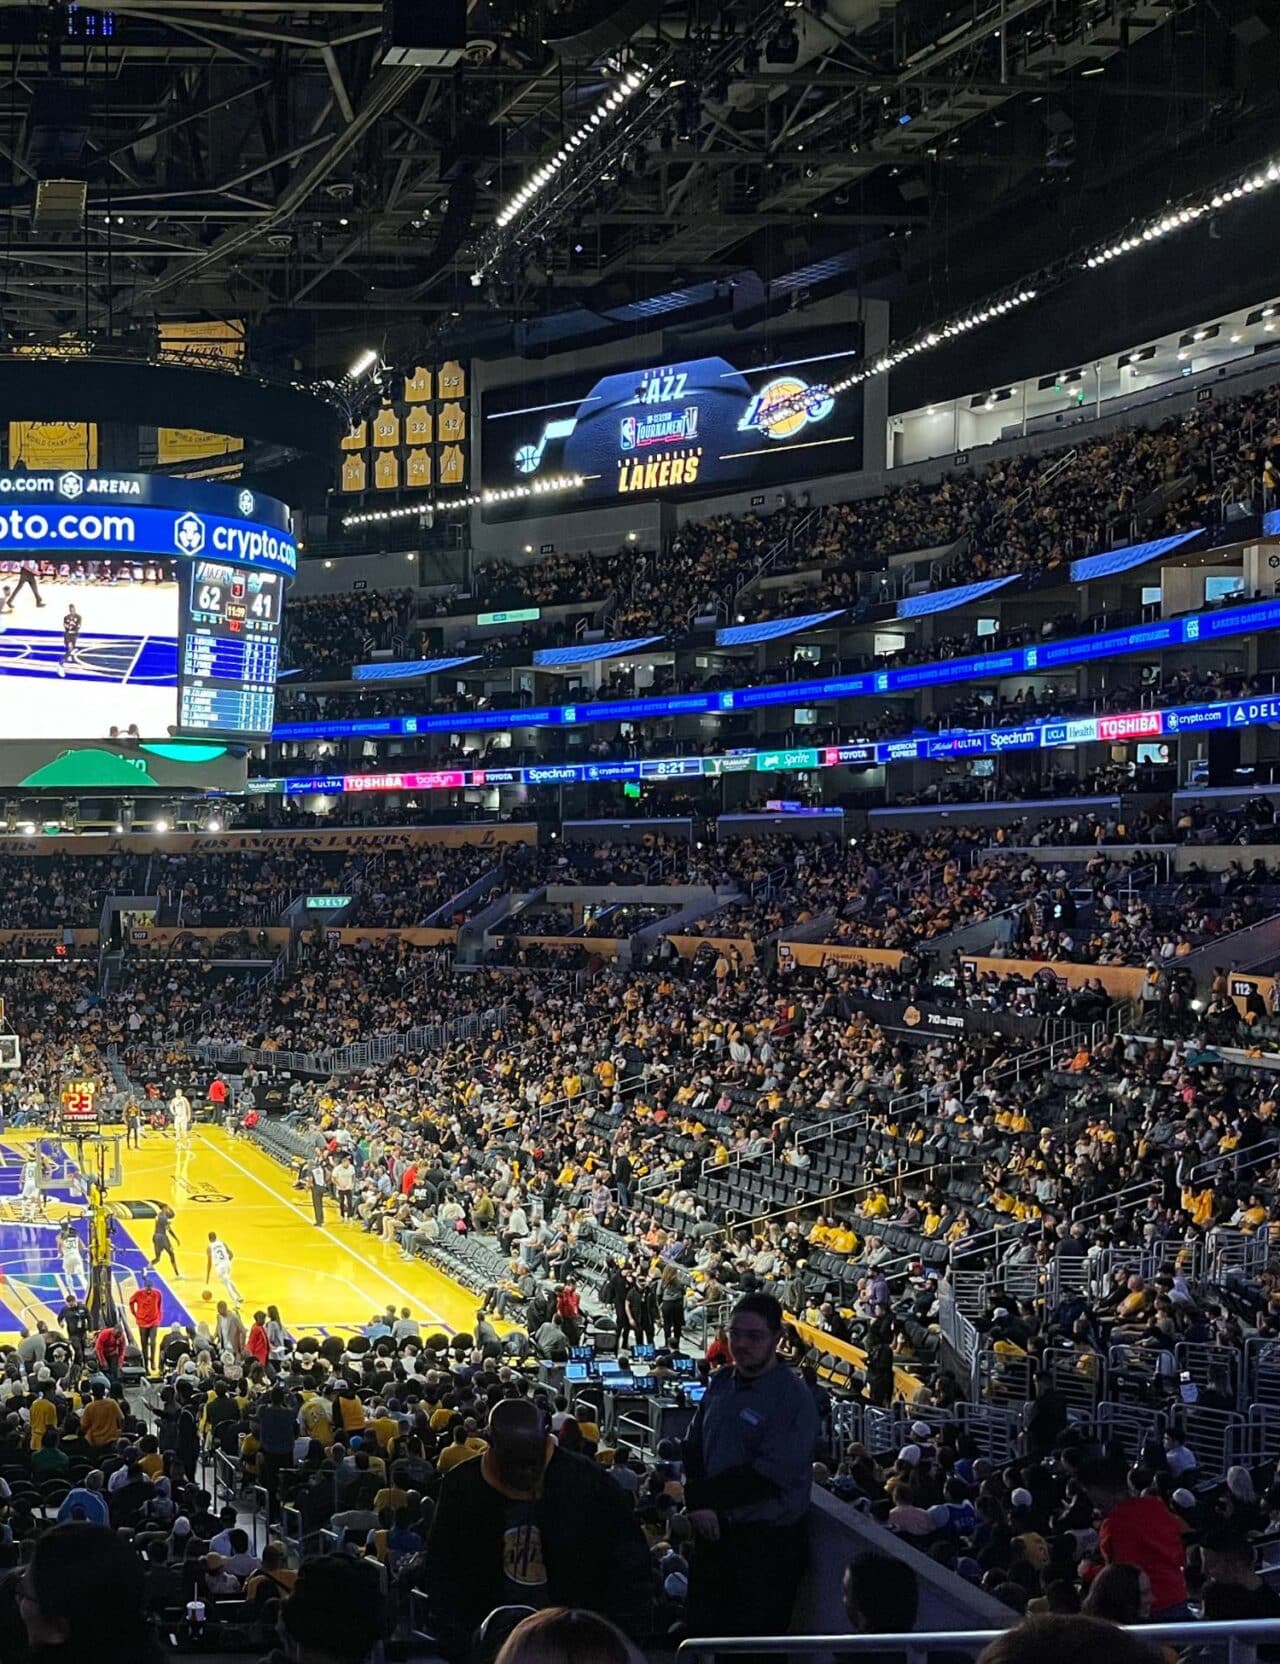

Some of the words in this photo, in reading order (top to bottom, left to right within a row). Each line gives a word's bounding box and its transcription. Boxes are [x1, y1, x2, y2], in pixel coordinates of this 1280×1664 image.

[444, 376, 460, 387] 25
[445, 418, 459, 430] 42
[635, 413, 689, 446] TOURNAMENT
[412, 463, 425, 474] 24
[618, 456, 700, 493] LAKERS
[87, 479, 141, 495] ARENA
[234, 585, 241, 596] 3
[199, 585, 221, 610] 62
[252, 593, 272, 618] 41
[1249, 702, 1280, 719] DEL
[1179, 711, 1221, 726] crypto.com
[1047, 729, 1064, 739] UCLA
[1069, 725, 1095, 738] Health
[1101, 716, 1158, 736] TOSHIBA
[958, 738, 982, 749] ULTRA
[991, 731, 1034, 748] Spectrum
[887, 742, 917, 752] AMERICAN
[784, 752, 810, 765] Sprite
[838, 750, 867, 760] TOYOTA
[891, 750, 917, 758] EXPRESS
[599, 767, 635, 776] crypto.com
[657, 762, 685, 774] 8:21
[416, 774, 453, 787] boldyn
[486, 773, 513, 781] TOYOTA
[529, 769, 575, 780] Spectrum
[317, 781, 342, 789] ULTRA
[348, 776, 402, 788] TOSHIBA
[191, 838, 231, 848] LOS
[239, 836, 324, 848] ANGELES
[327, 834, 412, 846] LAKERS
[318, 898, 350, 907] DELTA
[1235, 983, 1250, 995] 112
[927, 1014, 940, 1025] 710
[947, 1016, 964, 1027] ESPN
[68, 1093, 92, 1112] 23
[66, 1239, 77, 1250] 30
[216, 1248, 225, 1260] 3
